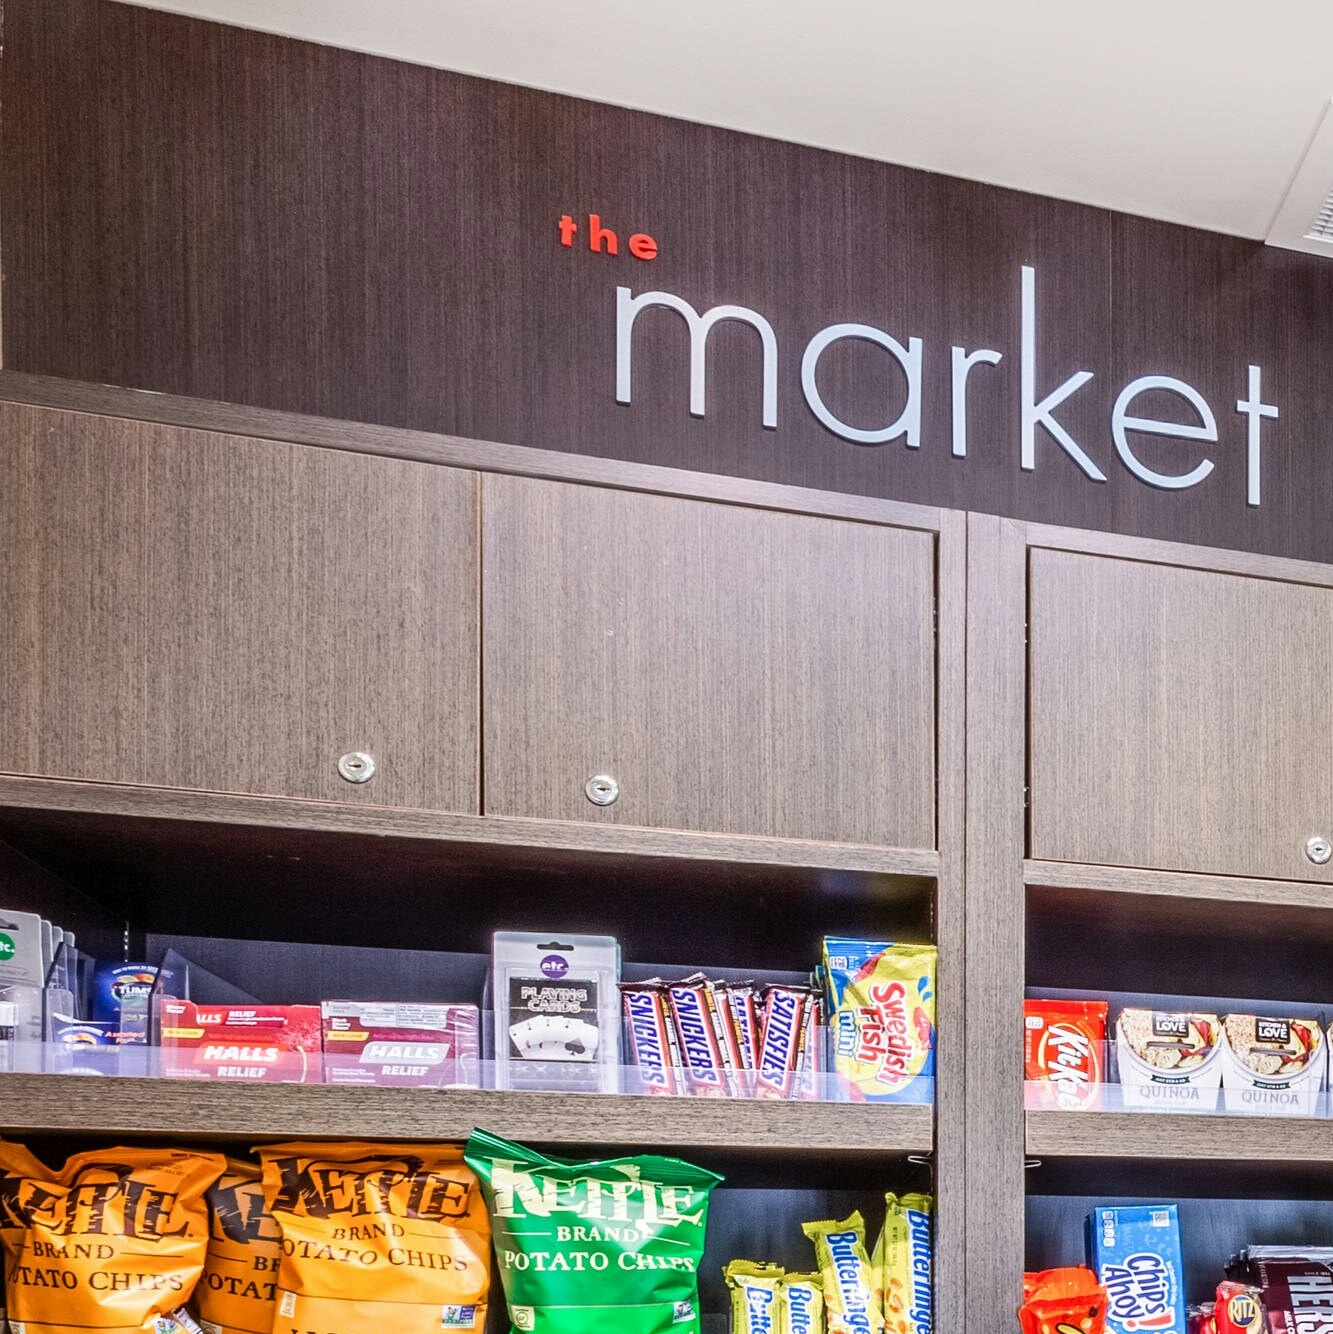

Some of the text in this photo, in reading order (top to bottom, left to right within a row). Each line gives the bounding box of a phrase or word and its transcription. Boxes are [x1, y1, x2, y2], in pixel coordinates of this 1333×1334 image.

[558, 214, 659, 261] the
[616, 265, 1279, 505] market
[521, 986, 587, 1000] PLAYING
[527, 999, 580, 1013] CARDS
[671, 987, 717, 1085] SNICKERS
[839, 1011, 856, 1058] mini
[858, 1008, 887, 1060] Fish
[872, 982, 909, 1084] Swedish
[1156, 1020, 1187, 1033] LOVE
[202, 1045, 278, 1062] HALLS
[217, 1066, 265, 1078] RELIEF
[1140, 1085, 1200, 1100] QUINOA
[266, 1154, 471, 1221] KETTLE
[491, 1157, 703, 1228] KETTLE
[505, 1251, 695, 1272] POTATO CHIPS
[1230, 1301, 1258, 1318] RITZ
